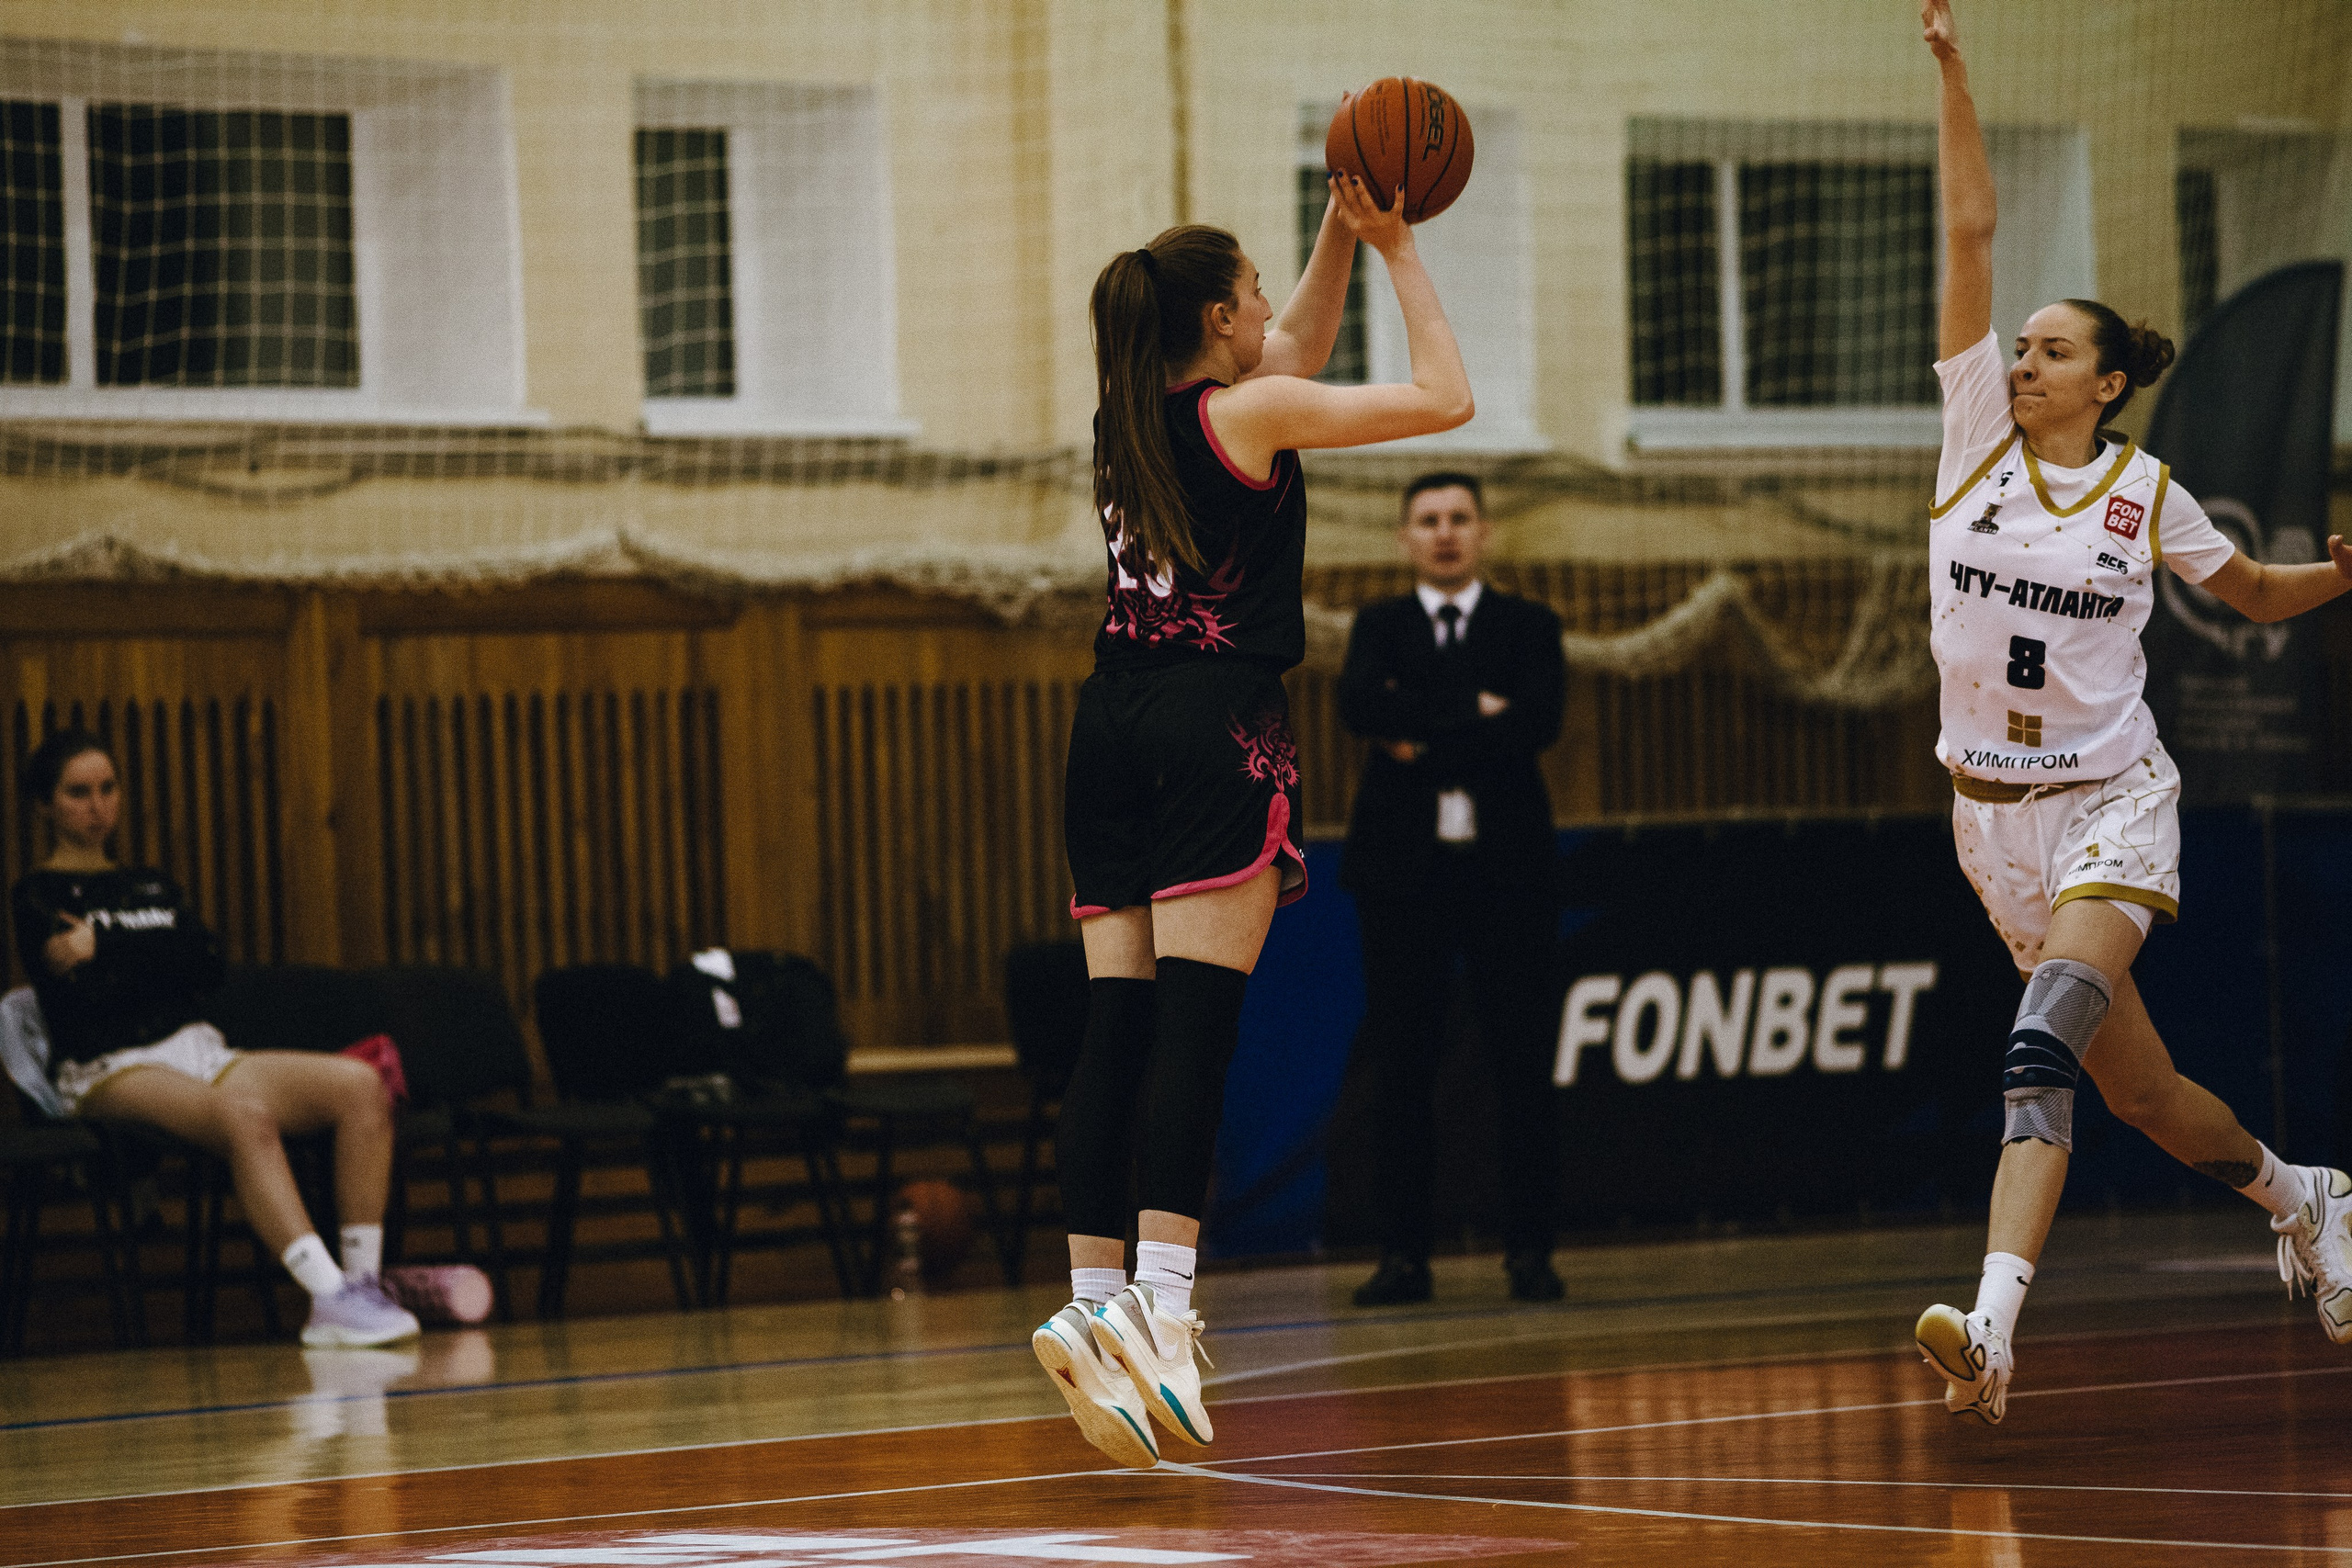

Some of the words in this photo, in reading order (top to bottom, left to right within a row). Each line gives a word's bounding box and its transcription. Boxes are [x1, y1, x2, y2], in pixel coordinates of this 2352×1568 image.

[2107, 513, 2138, 534] BET
[2109, 501, 2142, 521] FON
[1950, 559, 2124, 619] ЧГУ-АТЛАНТА
[2007, 635, 2046, 690] 8
[1962, 749, 2079, 770] ХИМПРОМ
[1553, 961, 1937, 1088] FONBET
